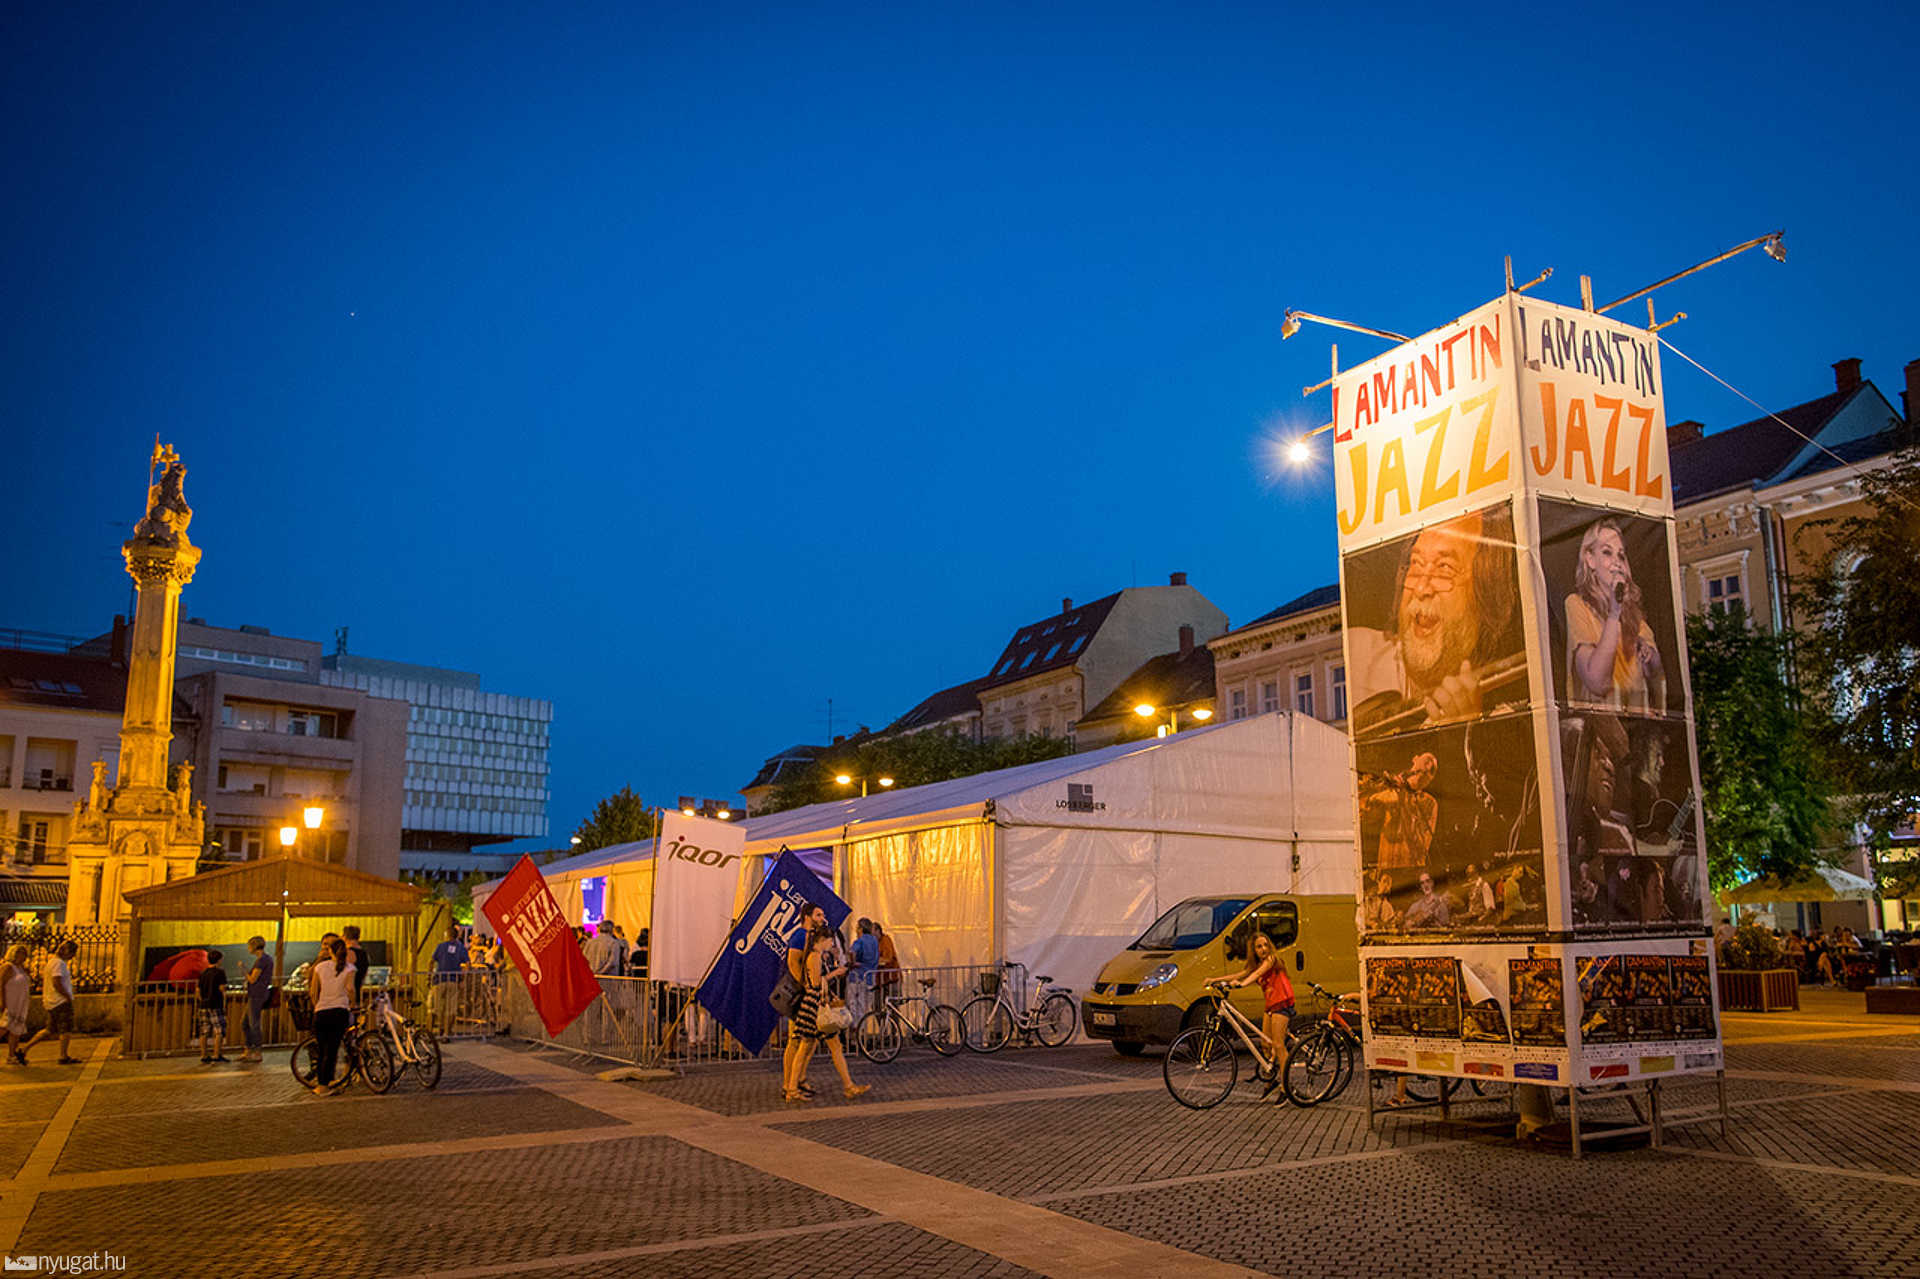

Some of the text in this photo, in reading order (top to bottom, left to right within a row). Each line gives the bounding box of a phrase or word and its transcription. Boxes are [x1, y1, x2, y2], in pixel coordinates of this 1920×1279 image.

[1332, 313, 1503, 444] LAMANTIN
[1518, 306, 1656, 398] LAMANTIN
[1337, 386, 1510, 536] JAZZ
[1530, 381, 1663, 499] JAZZ
[502, 888, 559, 985] jazz
